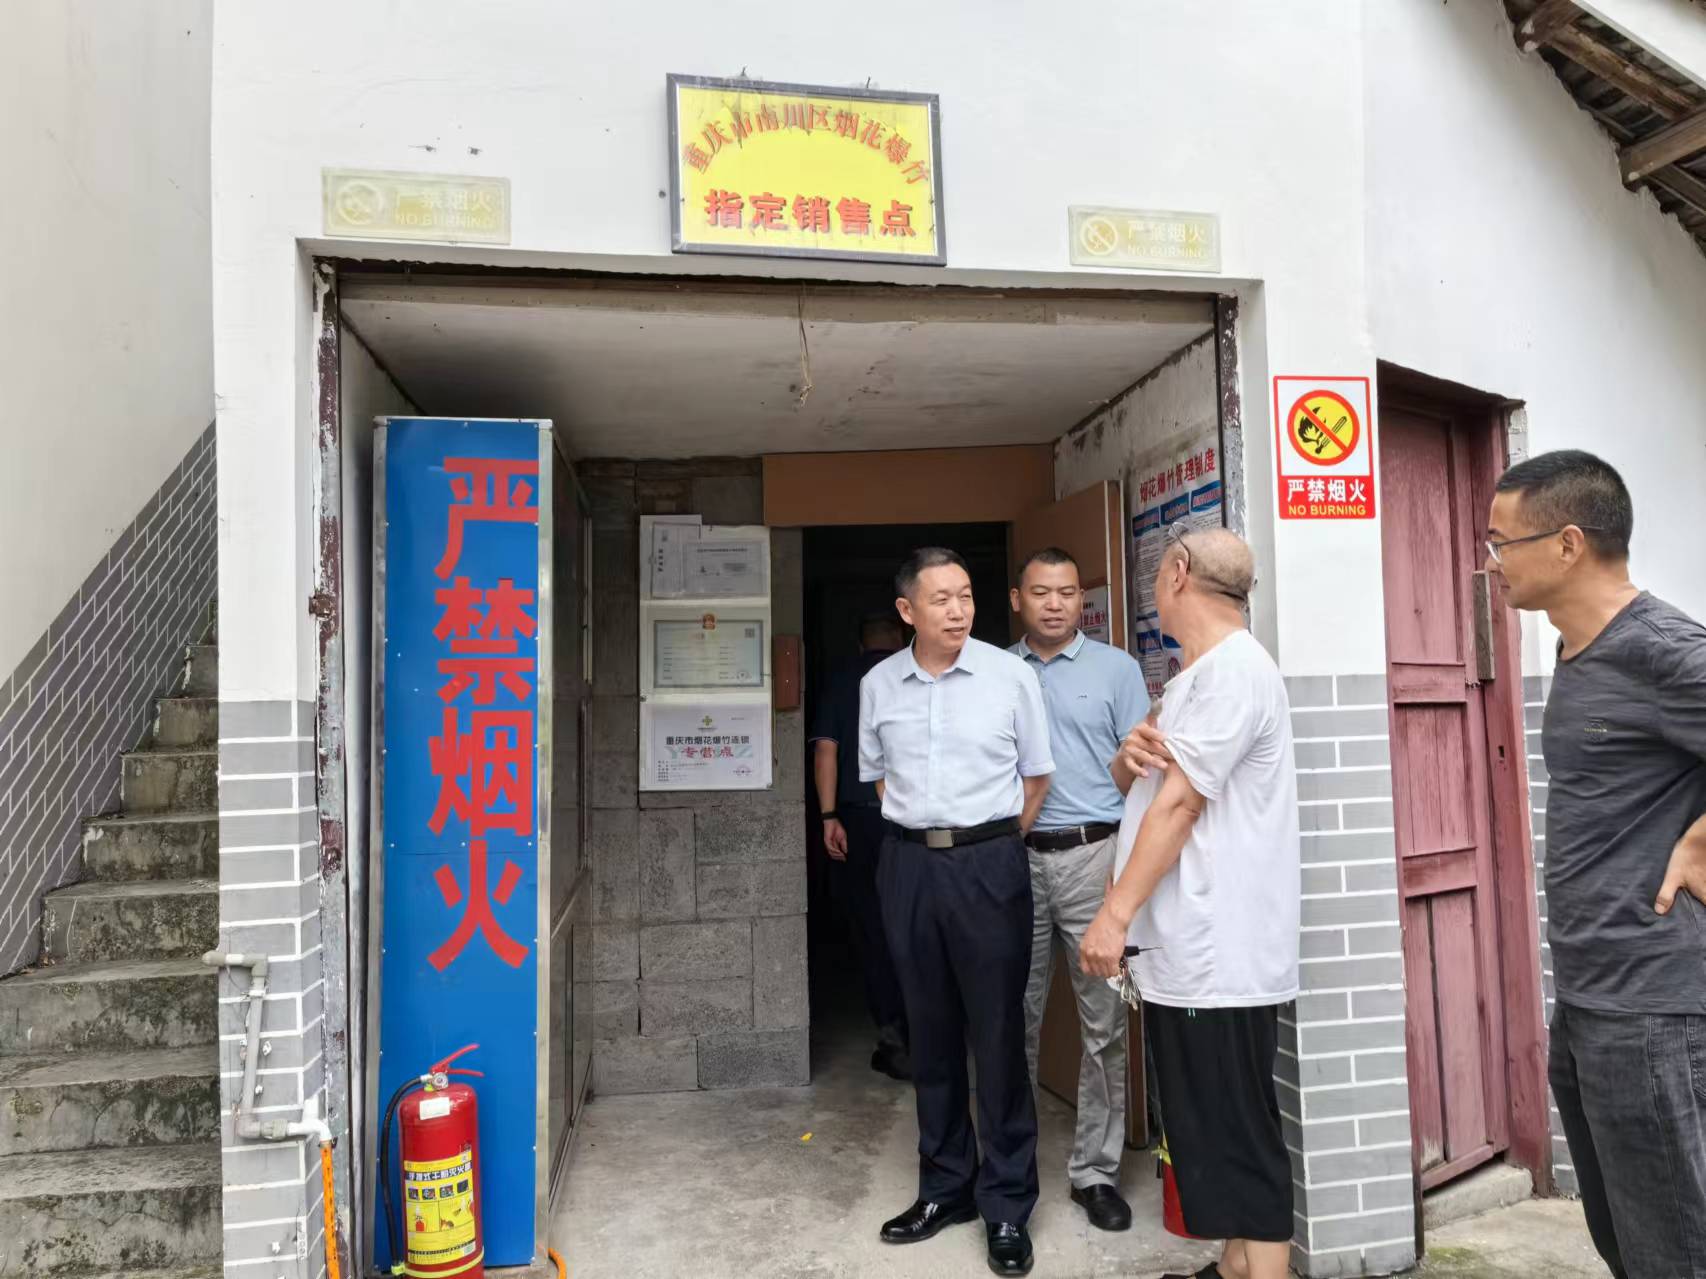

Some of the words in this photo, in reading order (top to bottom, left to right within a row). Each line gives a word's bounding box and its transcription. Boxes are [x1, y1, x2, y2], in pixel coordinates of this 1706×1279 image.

[682, 103, 929, 186] 重庆市南川区烟花爆竹
[704, 189, 916, 237] 指定销售点
[1128, 221, 1206, 242] 严禁烟火
[1139, 448, 1216, 503] 烟花爆竹管理制度
[1287, 479, 1367, 502] 严禁烟火
[1288, 505, 1306, 516] NO
[1311, 505, 1366, 516] BURNING
[427, 456, 539, 973] 严禁烟火
